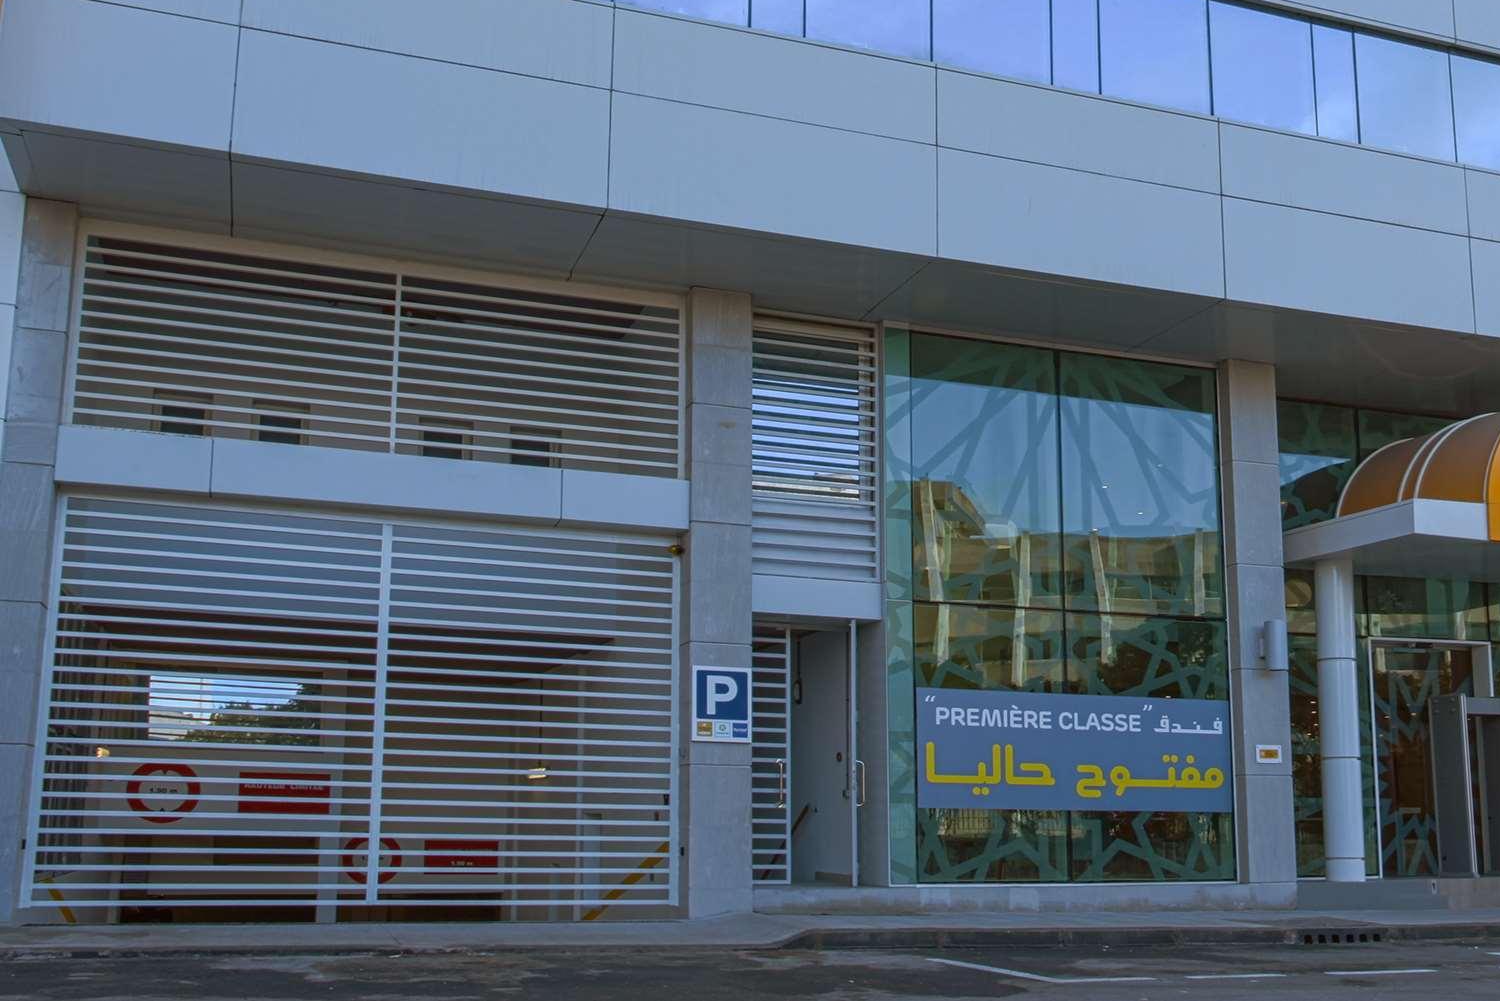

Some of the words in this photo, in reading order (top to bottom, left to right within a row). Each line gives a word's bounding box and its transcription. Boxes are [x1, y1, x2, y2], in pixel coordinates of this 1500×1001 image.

[706, 674, 738, 715] P
[1153, 716, 1224, 736] فندق
[925, 741, 1056, 797] حاليا
[1075, 754, 1225, 798] مفتوح
